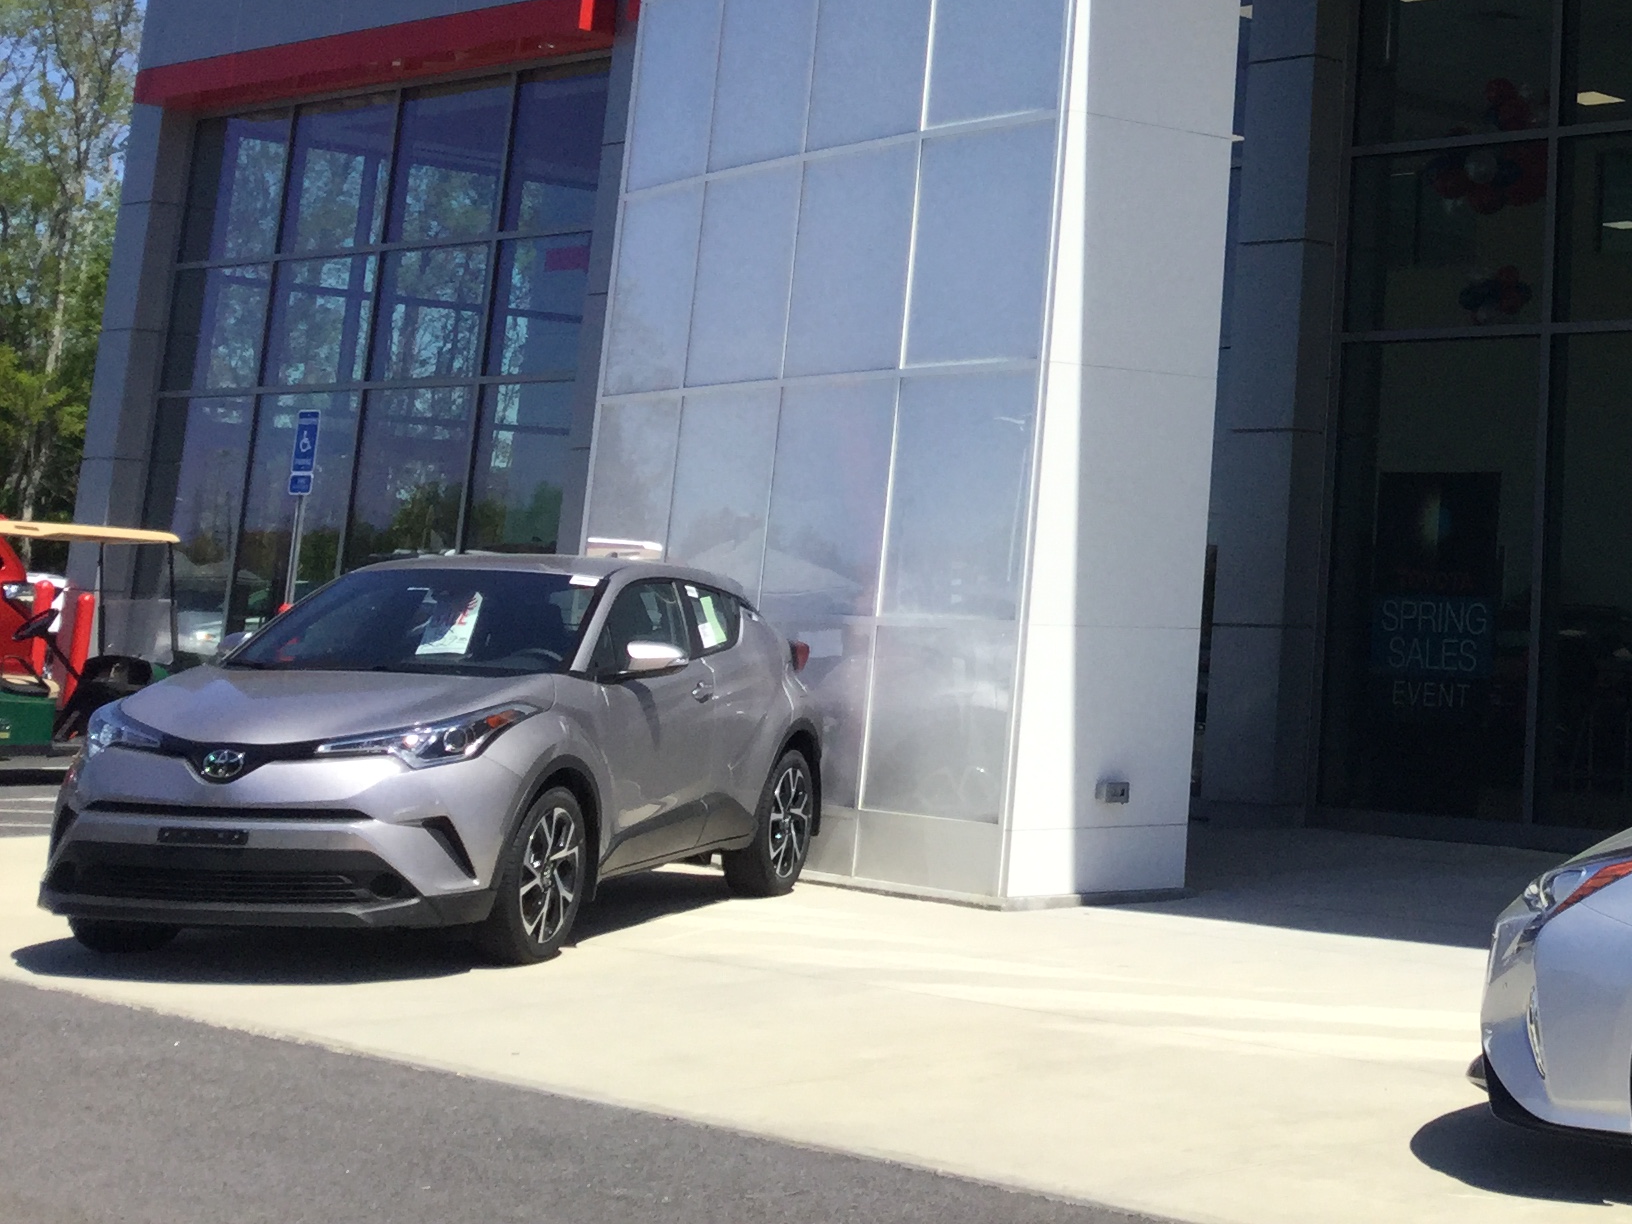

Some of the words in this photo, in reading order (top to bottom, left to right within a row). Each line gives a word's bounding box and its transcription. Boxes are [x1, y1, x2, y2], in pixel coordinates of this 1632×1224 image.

[1382, 600, 1487, 634] SPRING
[1389, 637, 1478, 672] SALES
[1391, 679, 1471, 708] EVENT
